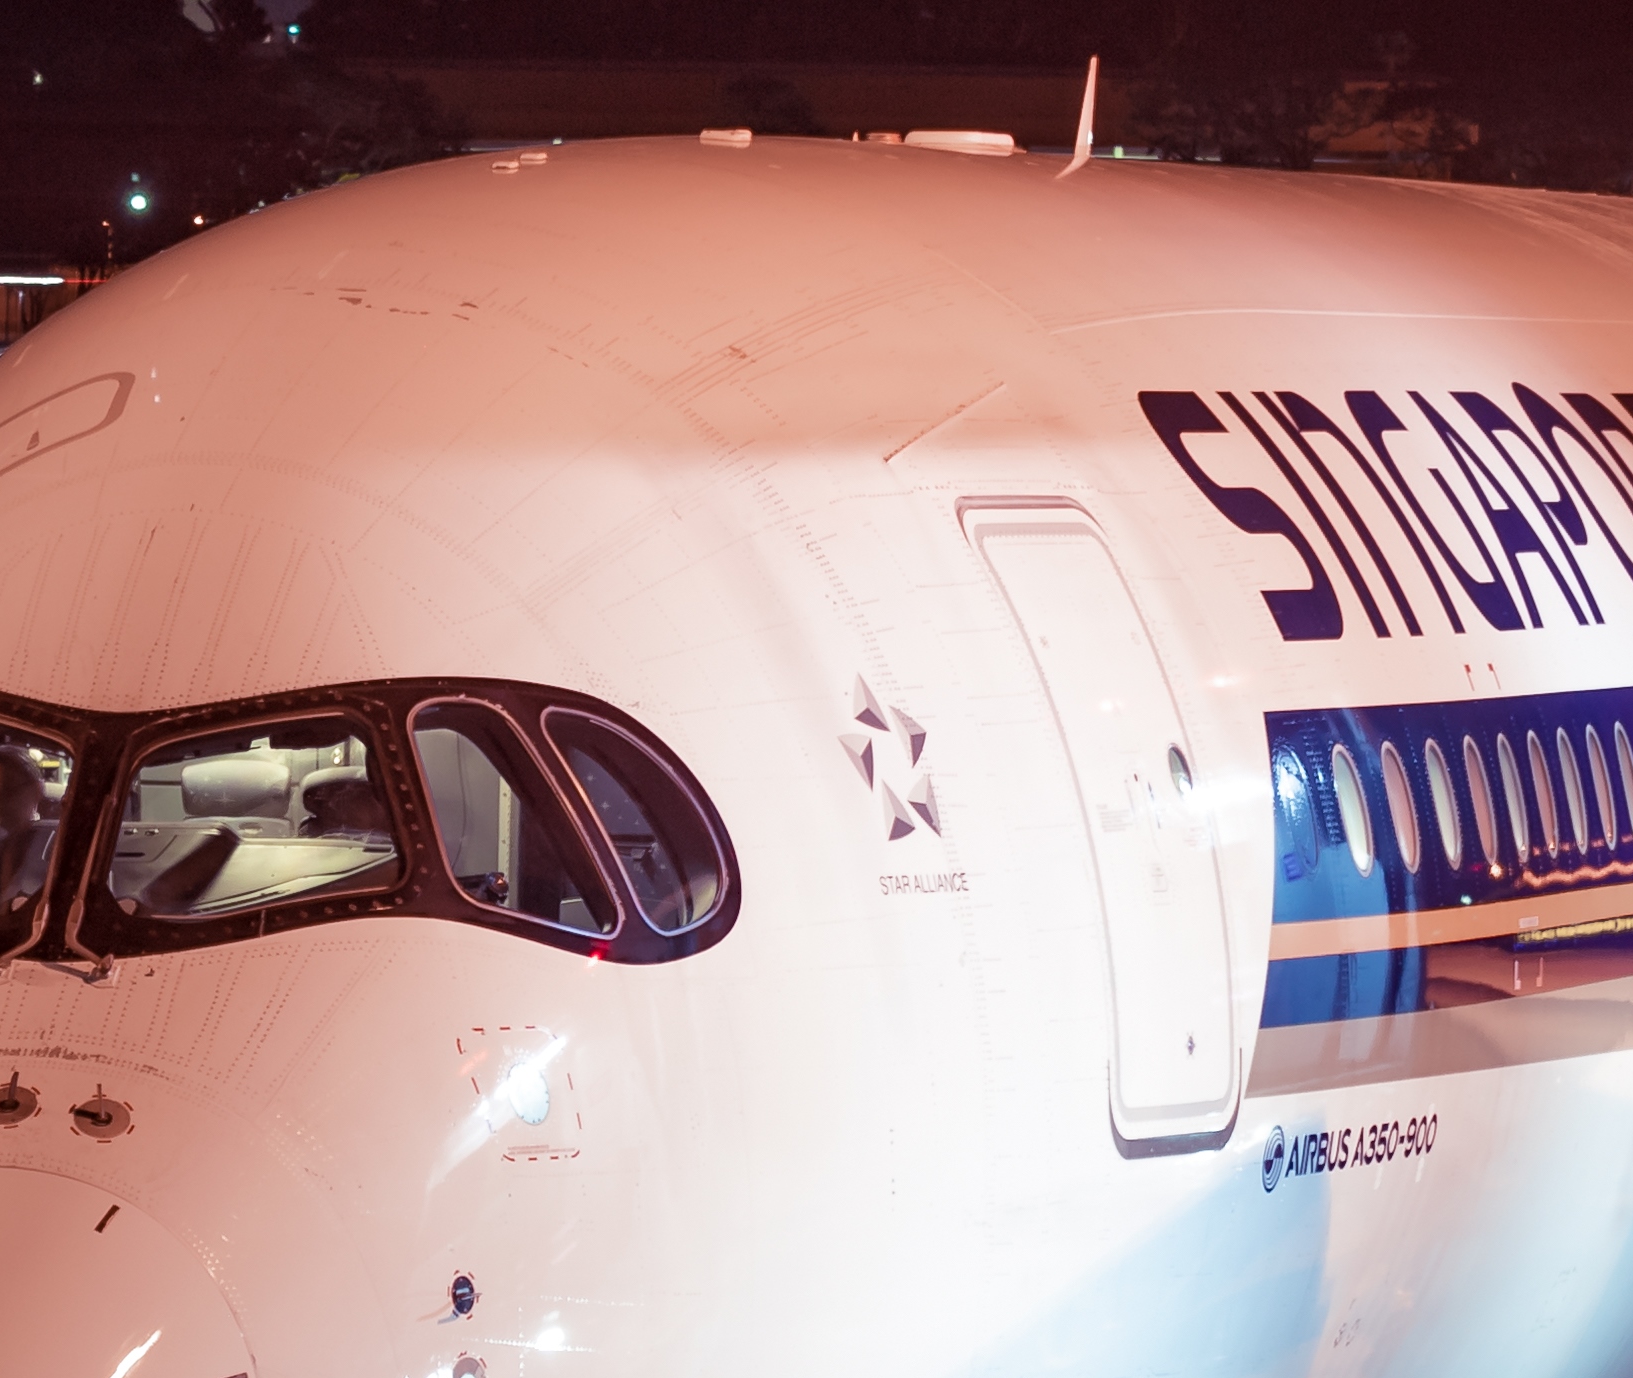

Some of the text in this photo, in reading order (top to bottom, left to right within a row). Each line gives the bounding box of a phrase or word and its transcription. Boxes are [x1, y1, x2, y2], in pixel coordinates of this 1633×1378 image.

[879, 872, 970, 896] STAR ALLIANCE
[1284, 1113, 1438, 1178] AIRBUS A350-900
